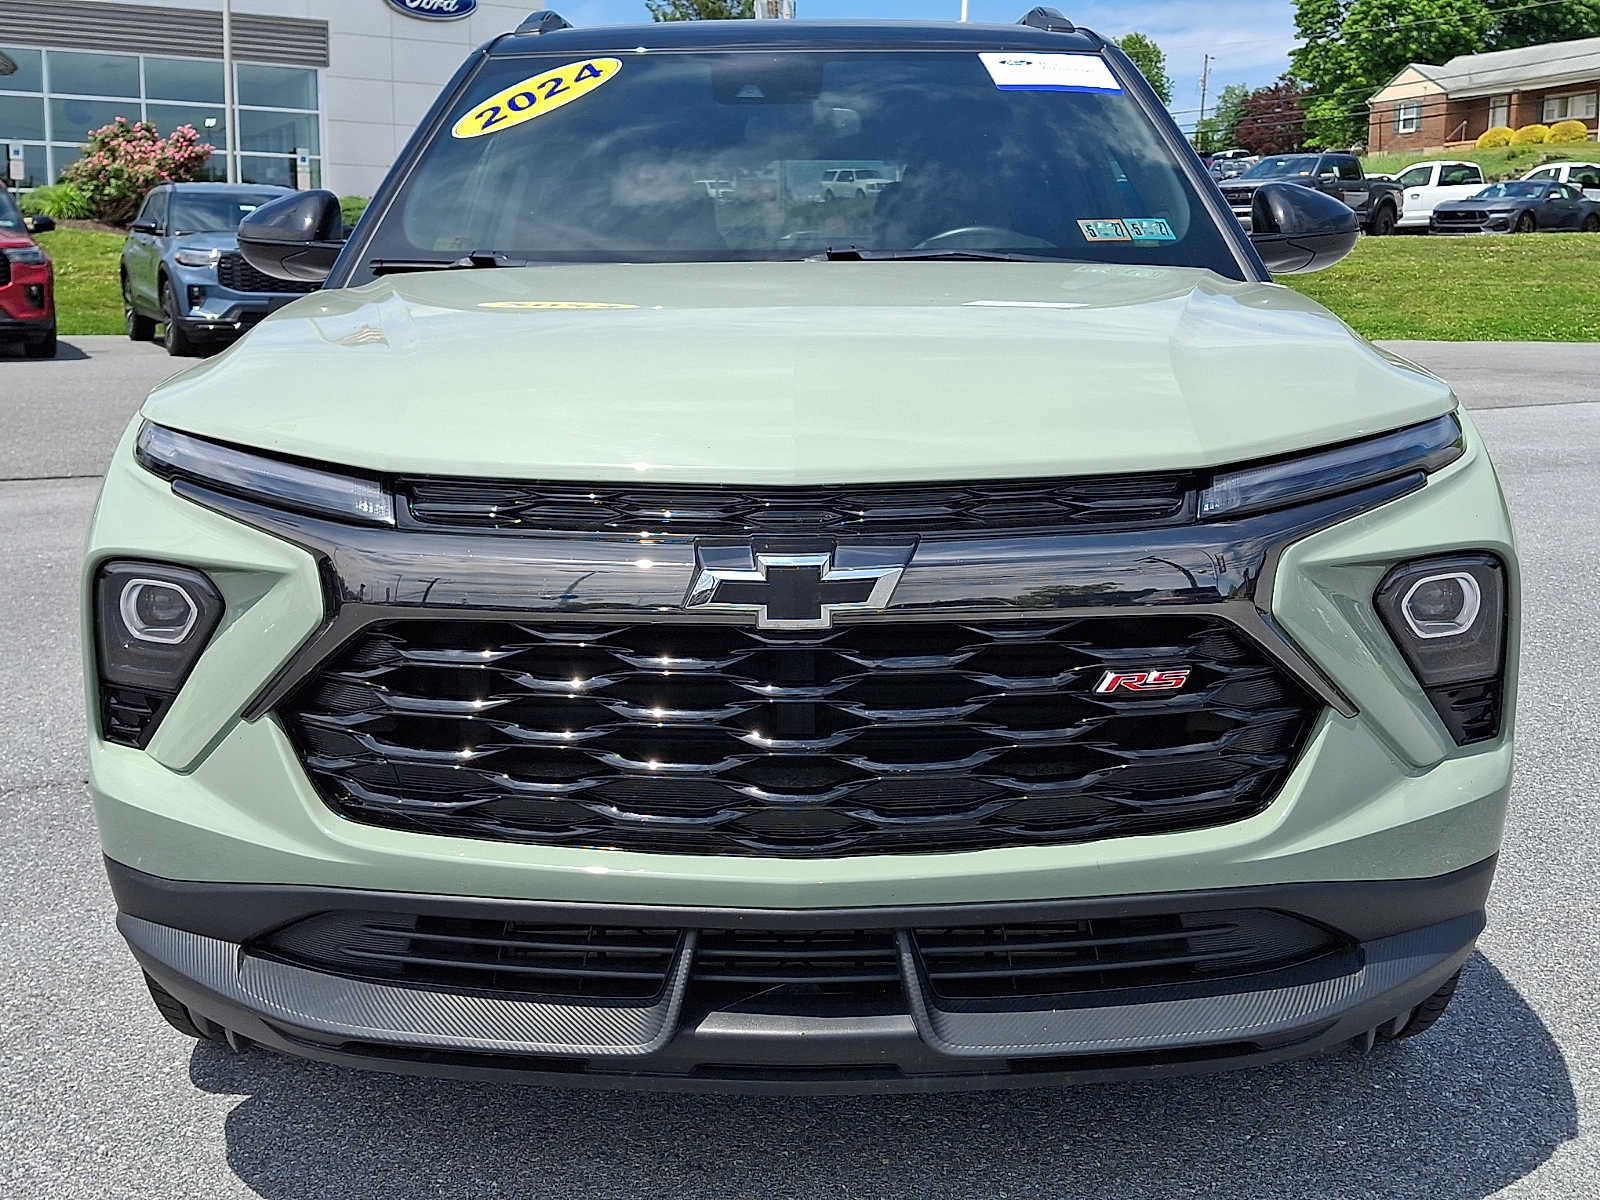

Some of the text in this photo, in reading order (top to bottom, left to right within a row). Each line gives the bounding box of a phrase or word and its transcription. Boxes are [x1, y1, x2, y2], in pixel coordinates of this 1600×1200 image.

[475, 63, 604, 130] 2024
[1085, 224, 1098, 238] 5
[1131, 223, 1143, 237] 5
[1095, 669, 1191, 693] RS
